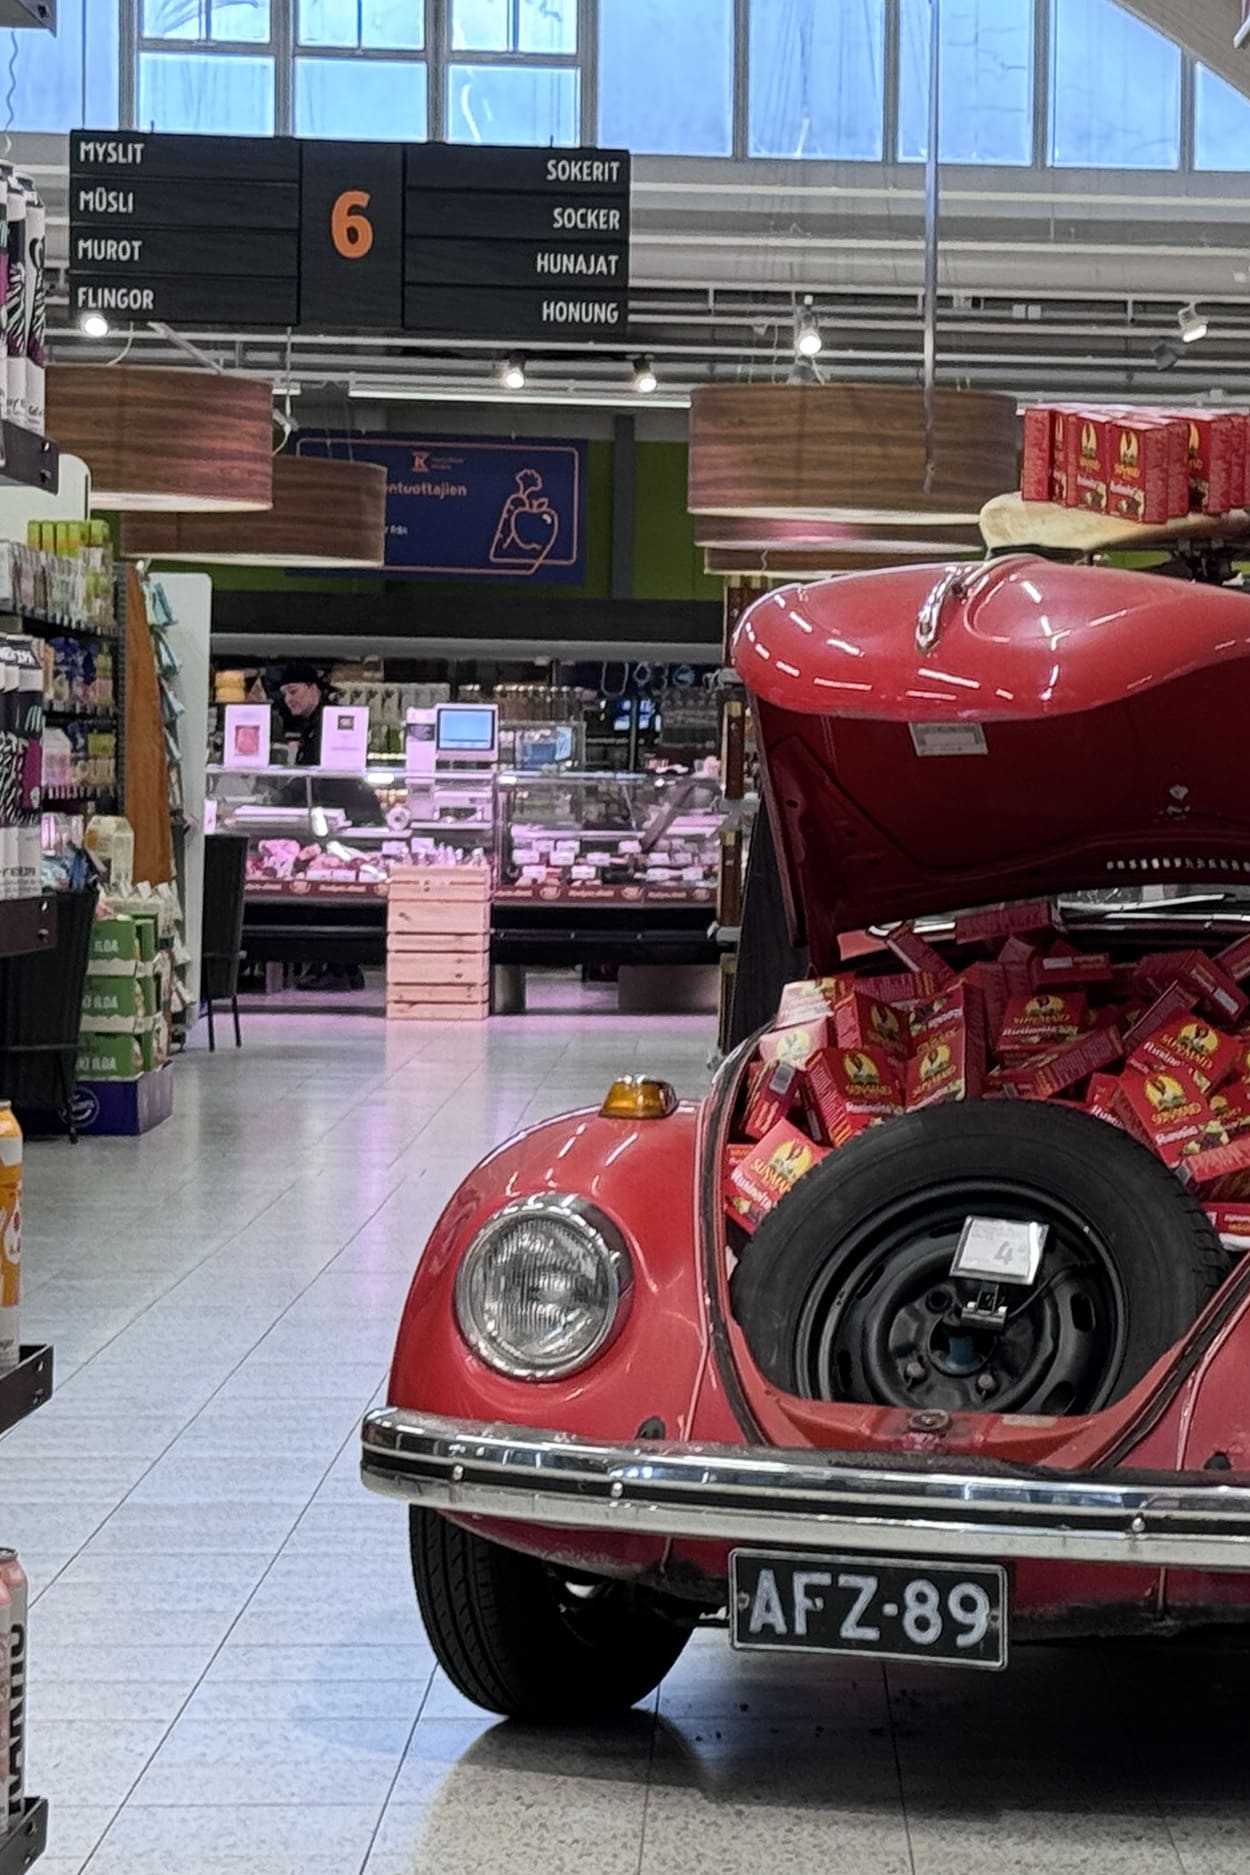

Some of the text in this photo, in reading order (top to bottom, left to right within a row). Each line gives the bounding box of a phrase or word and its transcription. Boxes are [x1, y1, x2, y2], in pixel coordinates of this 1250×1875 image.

[79, 141, 145, 165] MYSLIT
[546, 159, 621, 183] SOKERIT
[79, 187, 134, 213] MÜSLI
[332, 190, 373, 258] 6
[553, 207, 620, 230] SOCKER
[78, 239, 143, 262] MUROT
[536, 252, 619, 276] HUNAJAT
[78, 287, 154, 311] FLINGOR
[542, 300, 619, 324] HONUNG
[749, 1568, 990, 1649] AFZ-89
